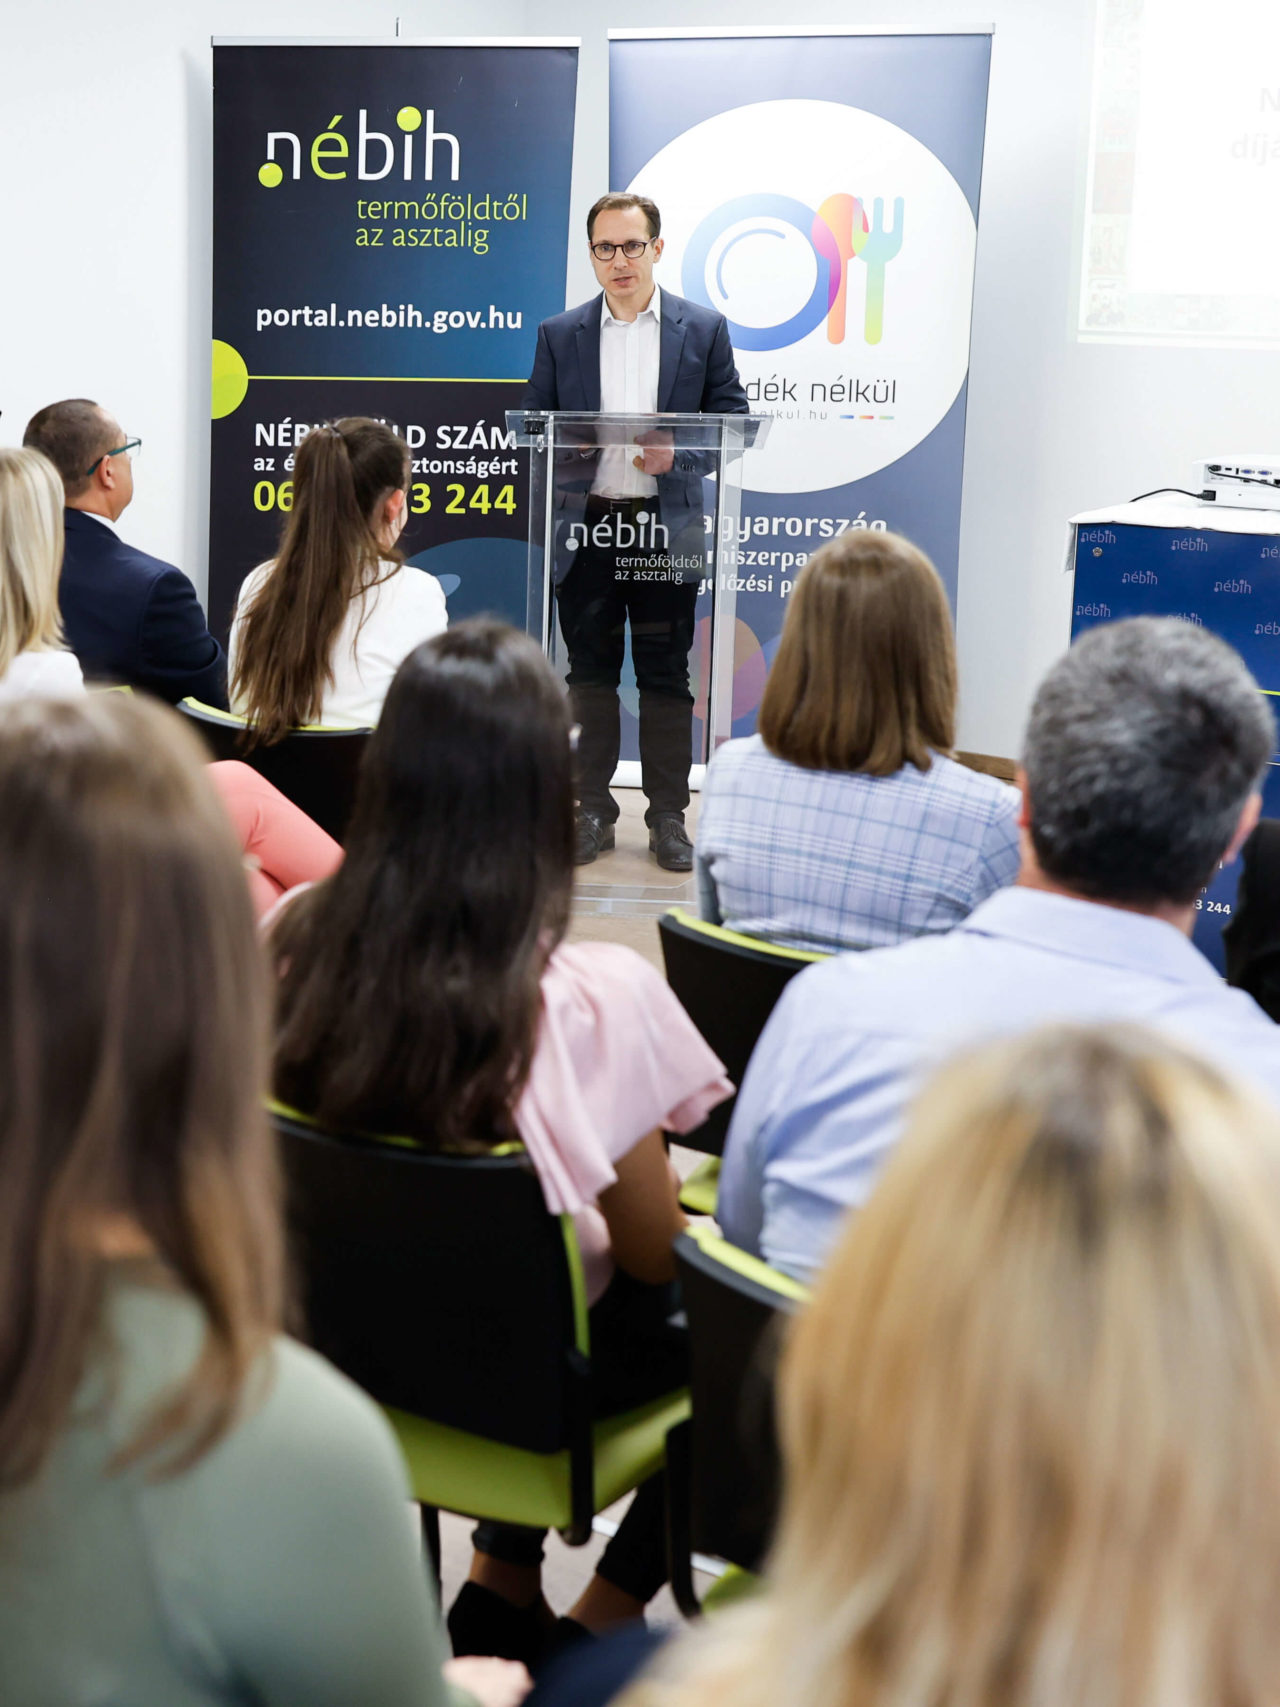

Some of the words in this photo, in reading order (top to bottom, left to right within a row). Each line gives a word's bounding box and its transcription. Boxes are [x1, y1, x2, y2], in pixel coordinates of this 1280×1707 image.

[258, 106, 460, 188] nébih
[356, 192, 527, 221] termőföldtől
[355, 227, 384, 247] az
[392, 220, 490, 254] asztalig
[256, 303, 523, 333] portal.nebih.gov.hu
[810, 374, 896, 404] nélkül
[436, 420, 518, 449] SZÁM
[253, 457, 276, 472] az
[408, 456, 518, 478] ztonságért
[253, 480, 294, 512] 06
[445, 483, 517, 515] 244
[565, 511, 669, 551] nébih
[1080, 530, 1116, 545] nébih
[1171, 537, 1208, 552] nébih
[615, 554, 703, 569] termőföldtől
[614, 570, 629, 581] az
[633, 568, 683, 585] asztalig
[1122, 570, 1158, 585] nébih
[1214, 579, 1252, 594] nébih
[1075, 603, 1111, 617] nébih
[1206, 901, 1232, 915] 244
